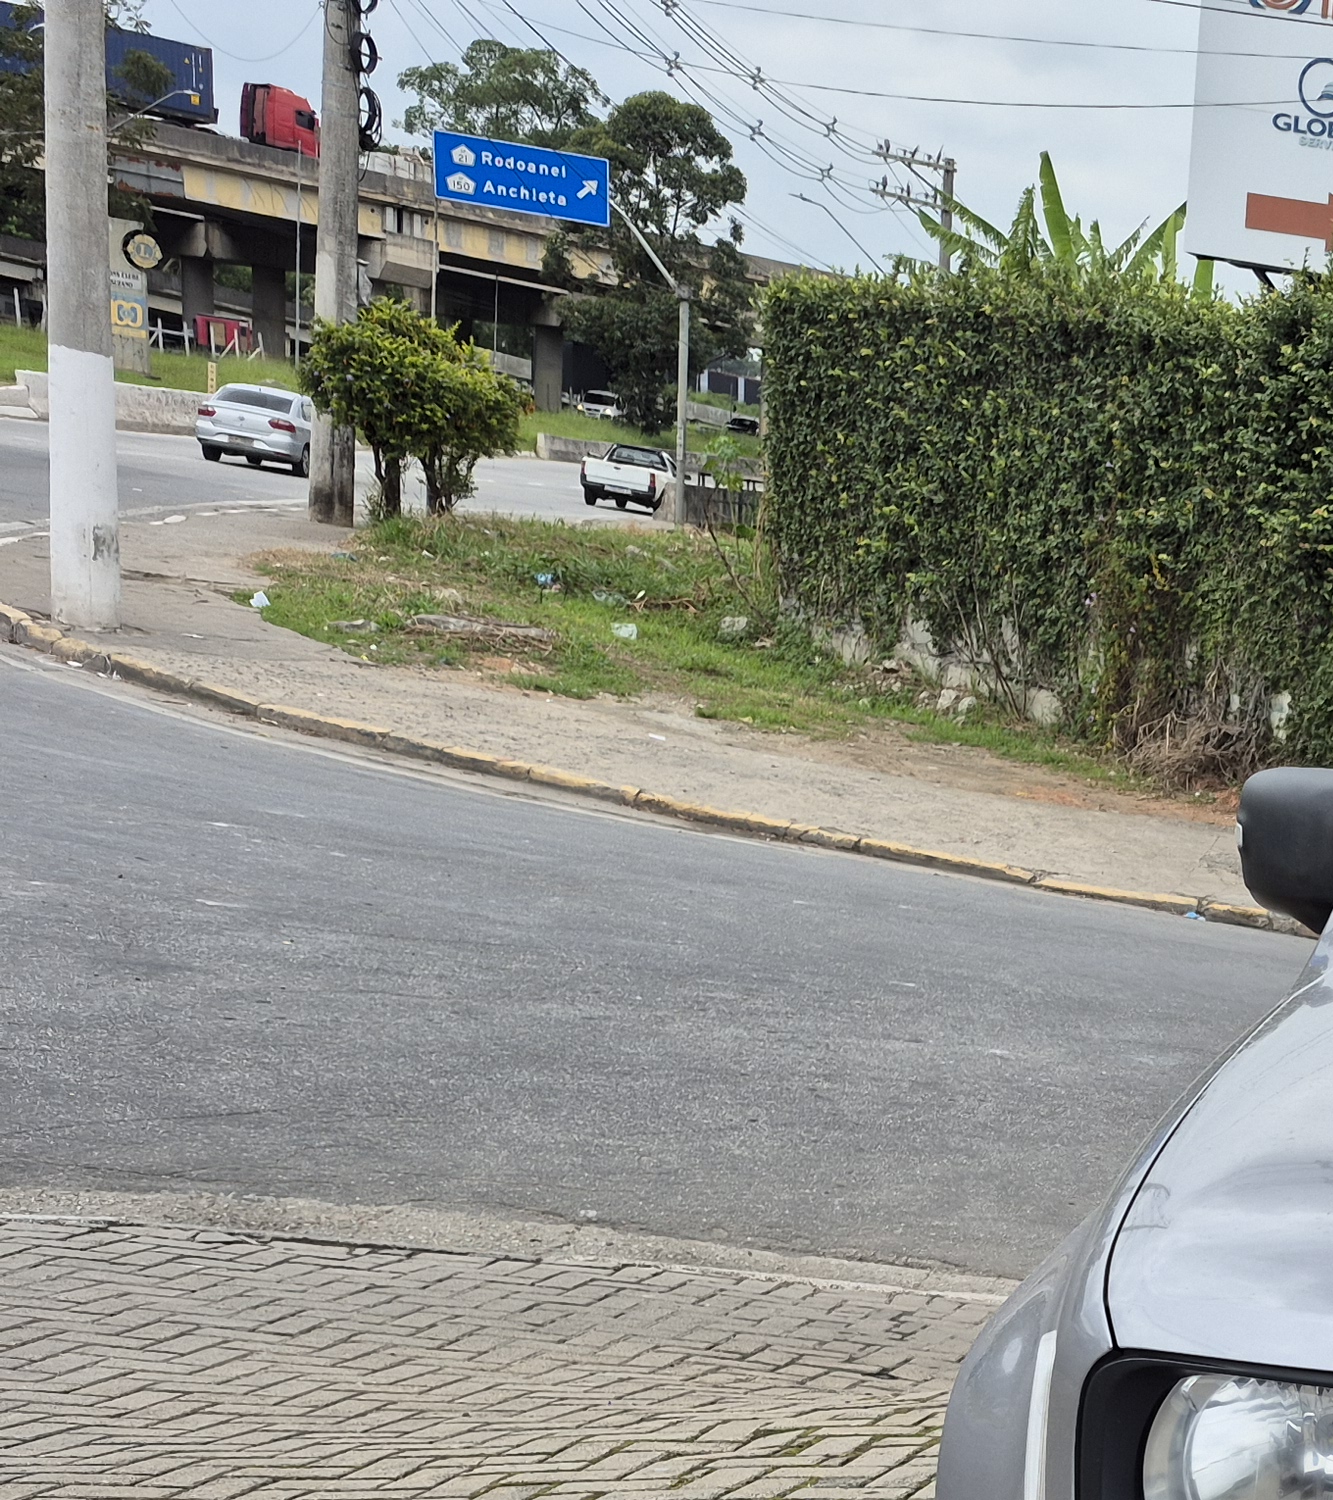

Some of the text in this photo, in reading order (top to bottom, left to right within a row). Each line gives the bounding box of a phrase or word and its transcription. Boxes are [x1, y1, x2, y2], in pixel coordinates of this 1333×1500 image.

[458, 151, 567, 179] 21 Rodoanel
[452, 180, 567, 206] 150 Anchieta
